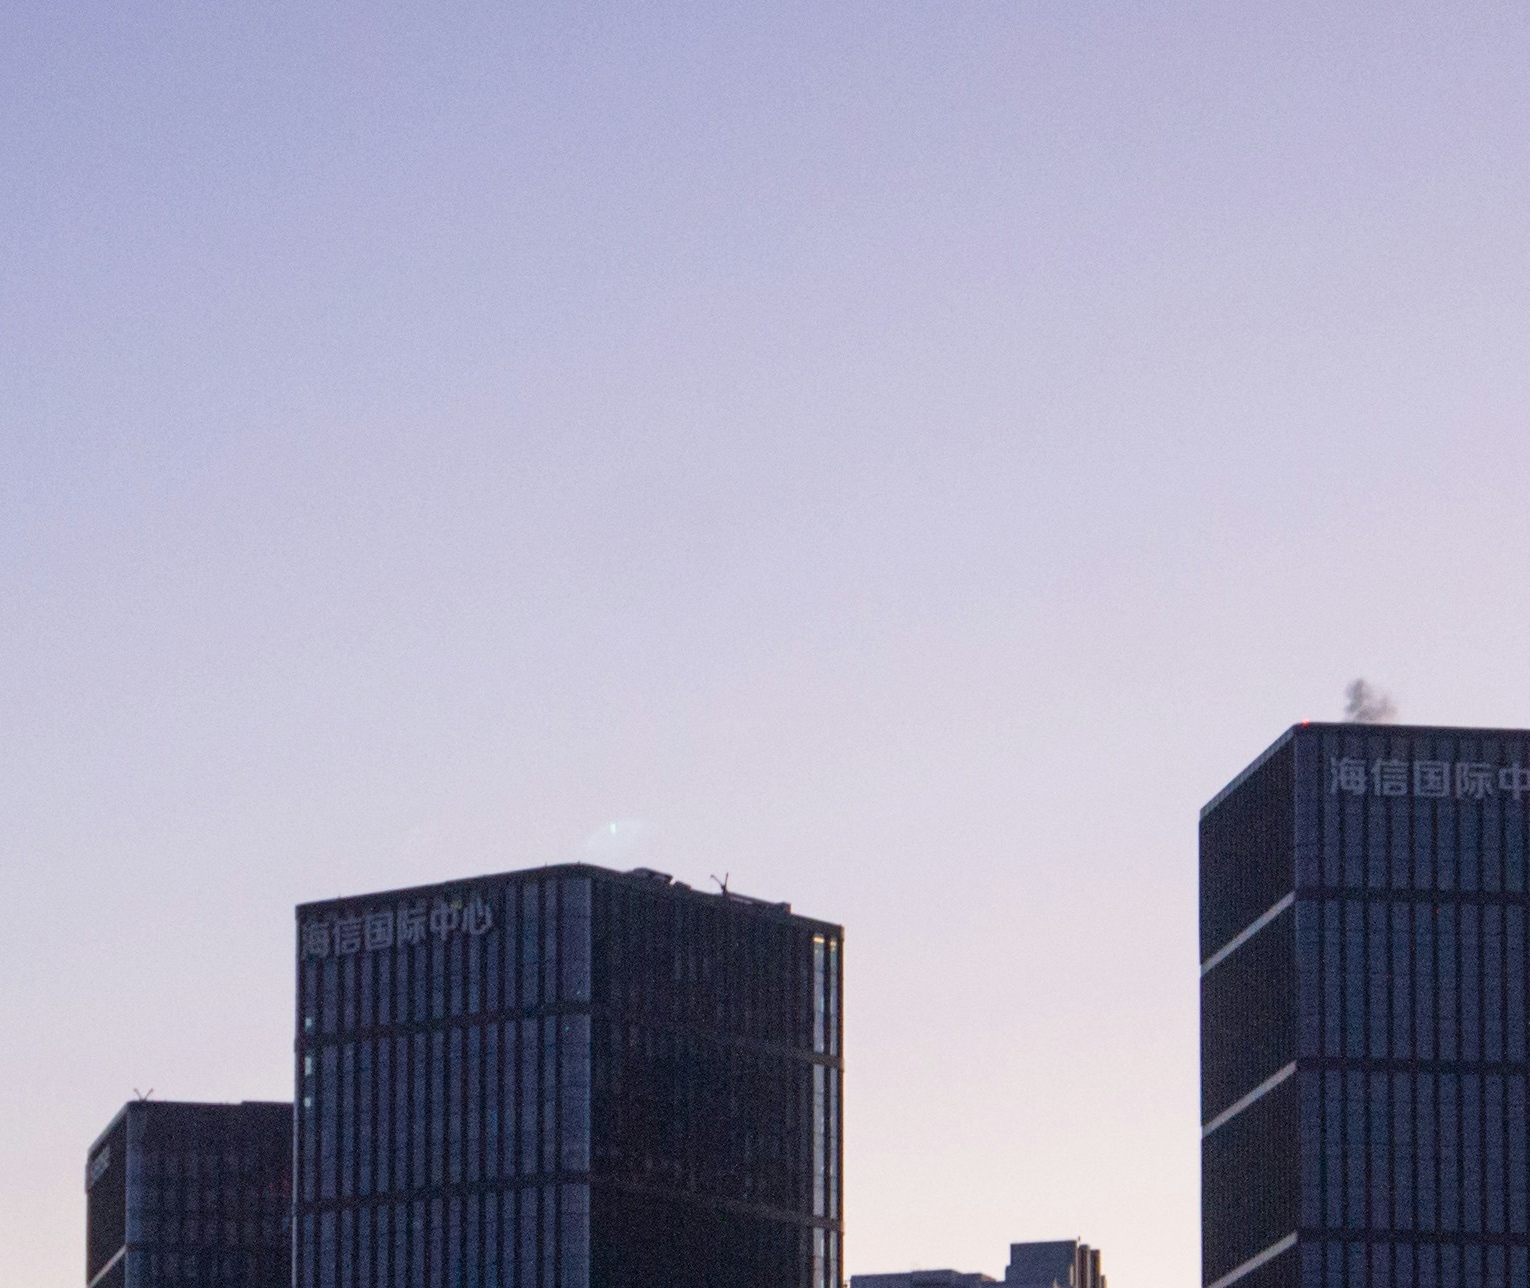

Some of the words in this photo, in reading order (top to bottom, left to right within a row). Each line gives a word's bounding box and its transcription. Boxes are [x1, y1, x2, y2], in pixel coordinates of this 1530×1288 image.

[301, 897, 493, 960] 海信国际中心
